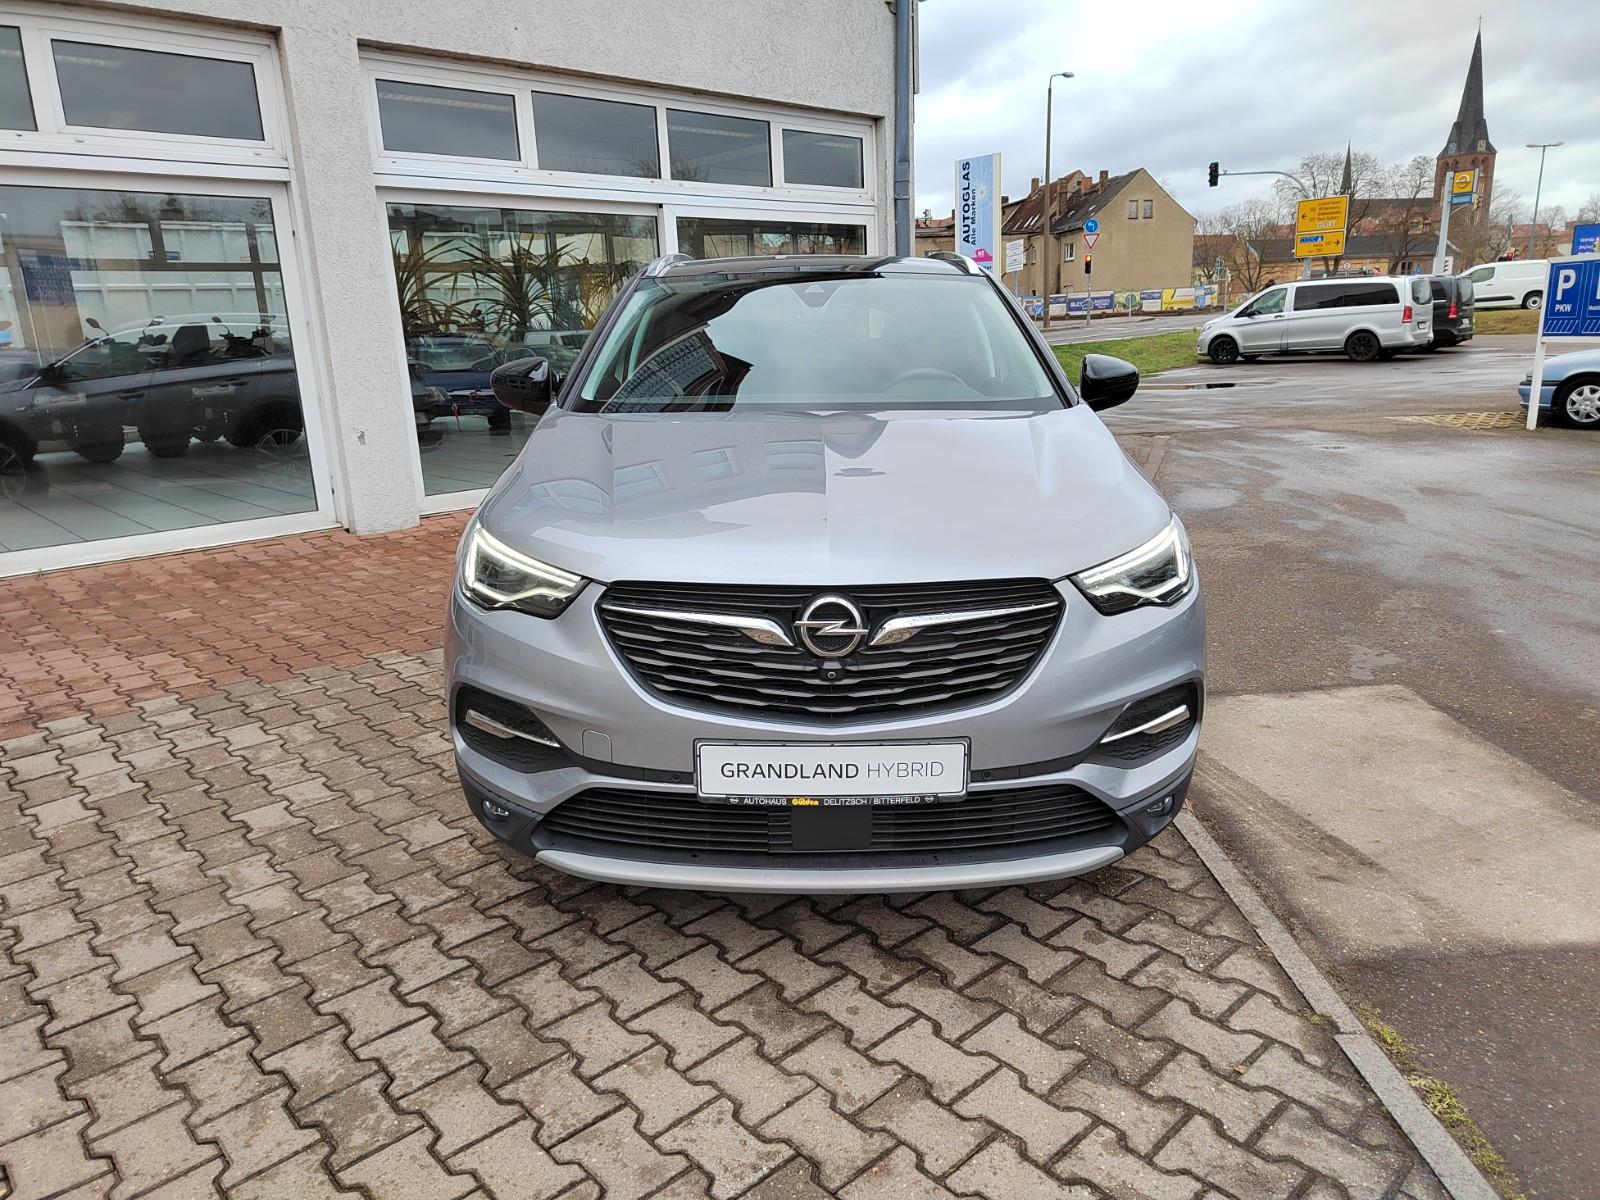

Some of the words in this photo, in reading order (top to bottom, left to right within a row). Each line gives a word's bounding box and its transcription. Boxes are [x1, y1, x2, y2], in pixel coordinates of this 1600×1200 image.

[962, 161, 971, 244] AUTOGLAS
[1556, 269, 1576, 300] P
[1554, 304, 1572, 313] PKW
[720, 762, 859, 779] GRANDLAND
[867, 761, 944, 778] HYBRID
[743, 798, 787, 806] AUTOHAUS
[823, 798, 867, 806] DELITZSCH
[873, 797, 921, 805] BITTERFELD
